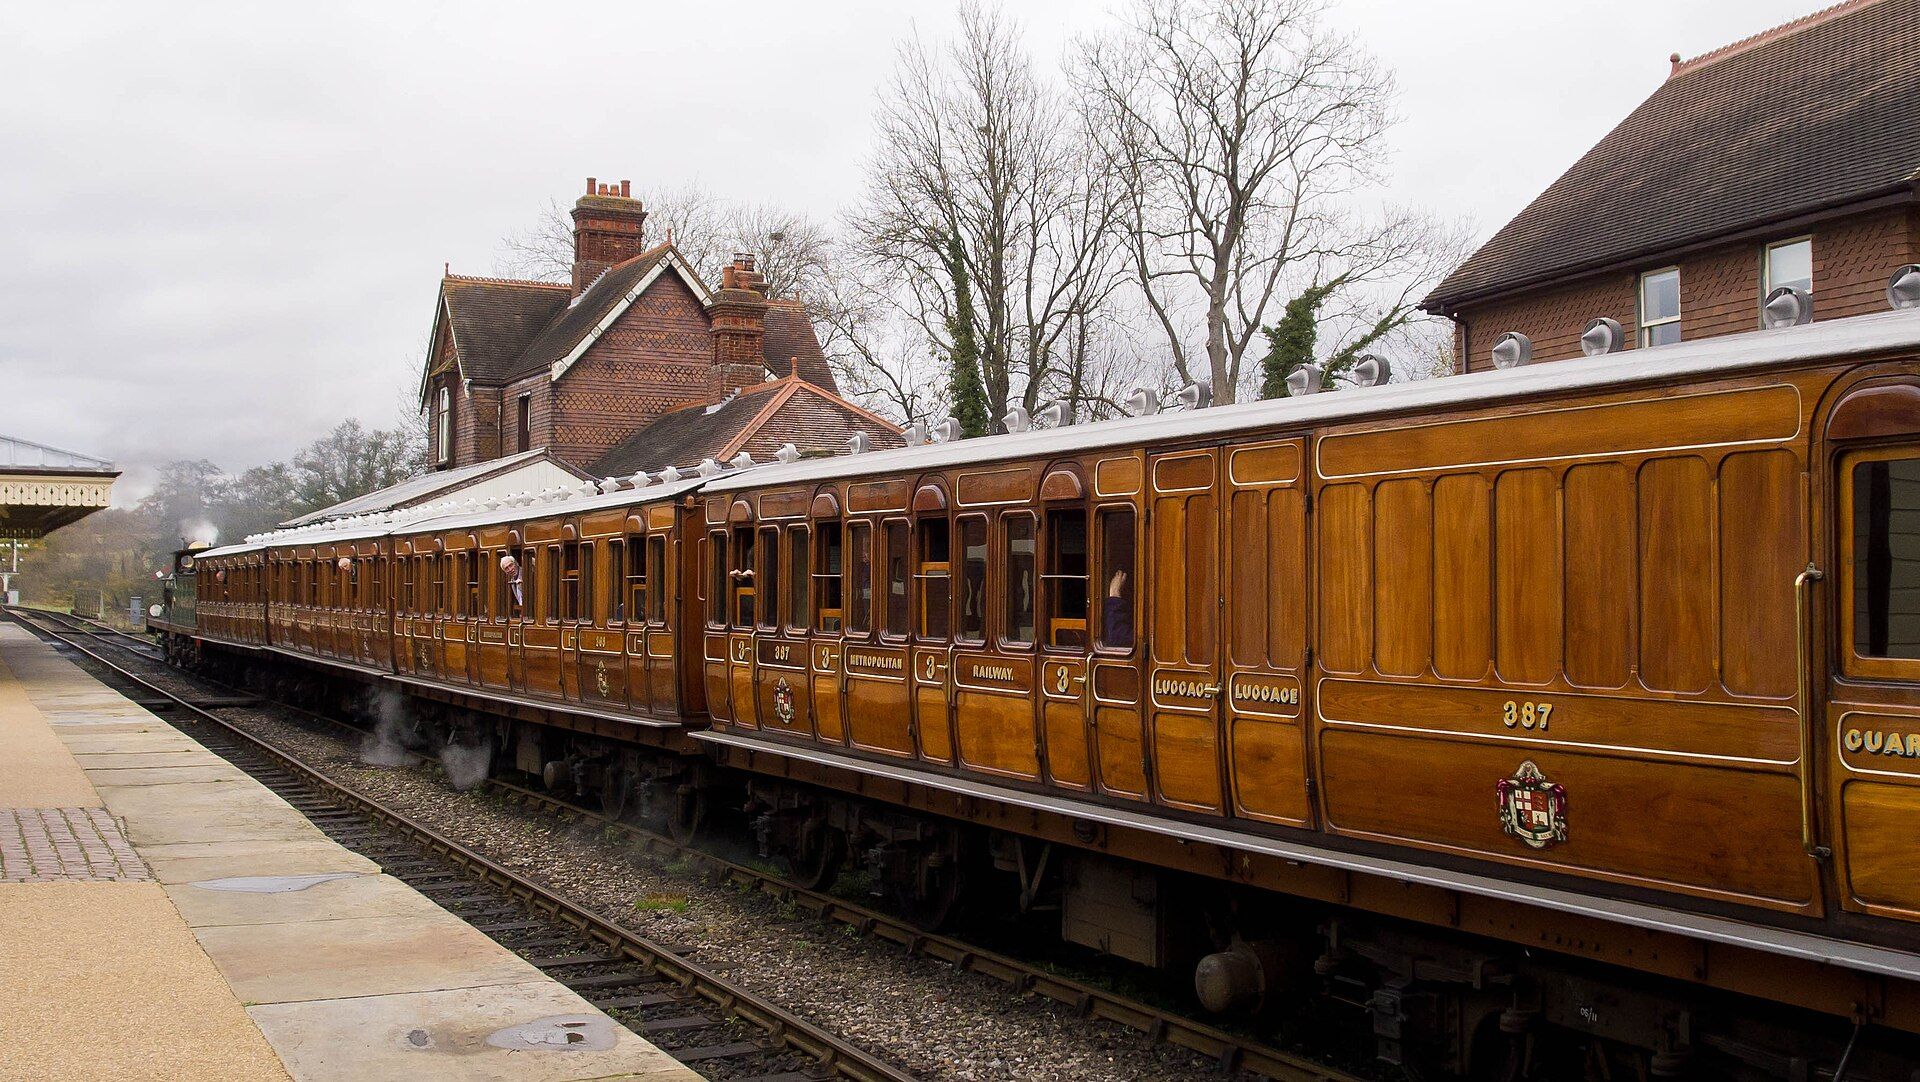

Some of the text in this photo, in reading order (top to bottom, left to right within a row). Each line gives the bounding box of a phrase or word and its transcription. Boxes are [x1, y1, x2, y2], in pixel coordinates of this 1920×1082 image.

[738, 640, 745, 660] 3
[822, 646, 831, 669] 3
[850, 654, 903, 670] METROPOLITAN
[926, 655, 936, 679] 3
[1056, 665, 1069, 693] 3
[1235, 683, 1299, 705] LUGGAGE
[1503, 700, 1554, 730] 387
